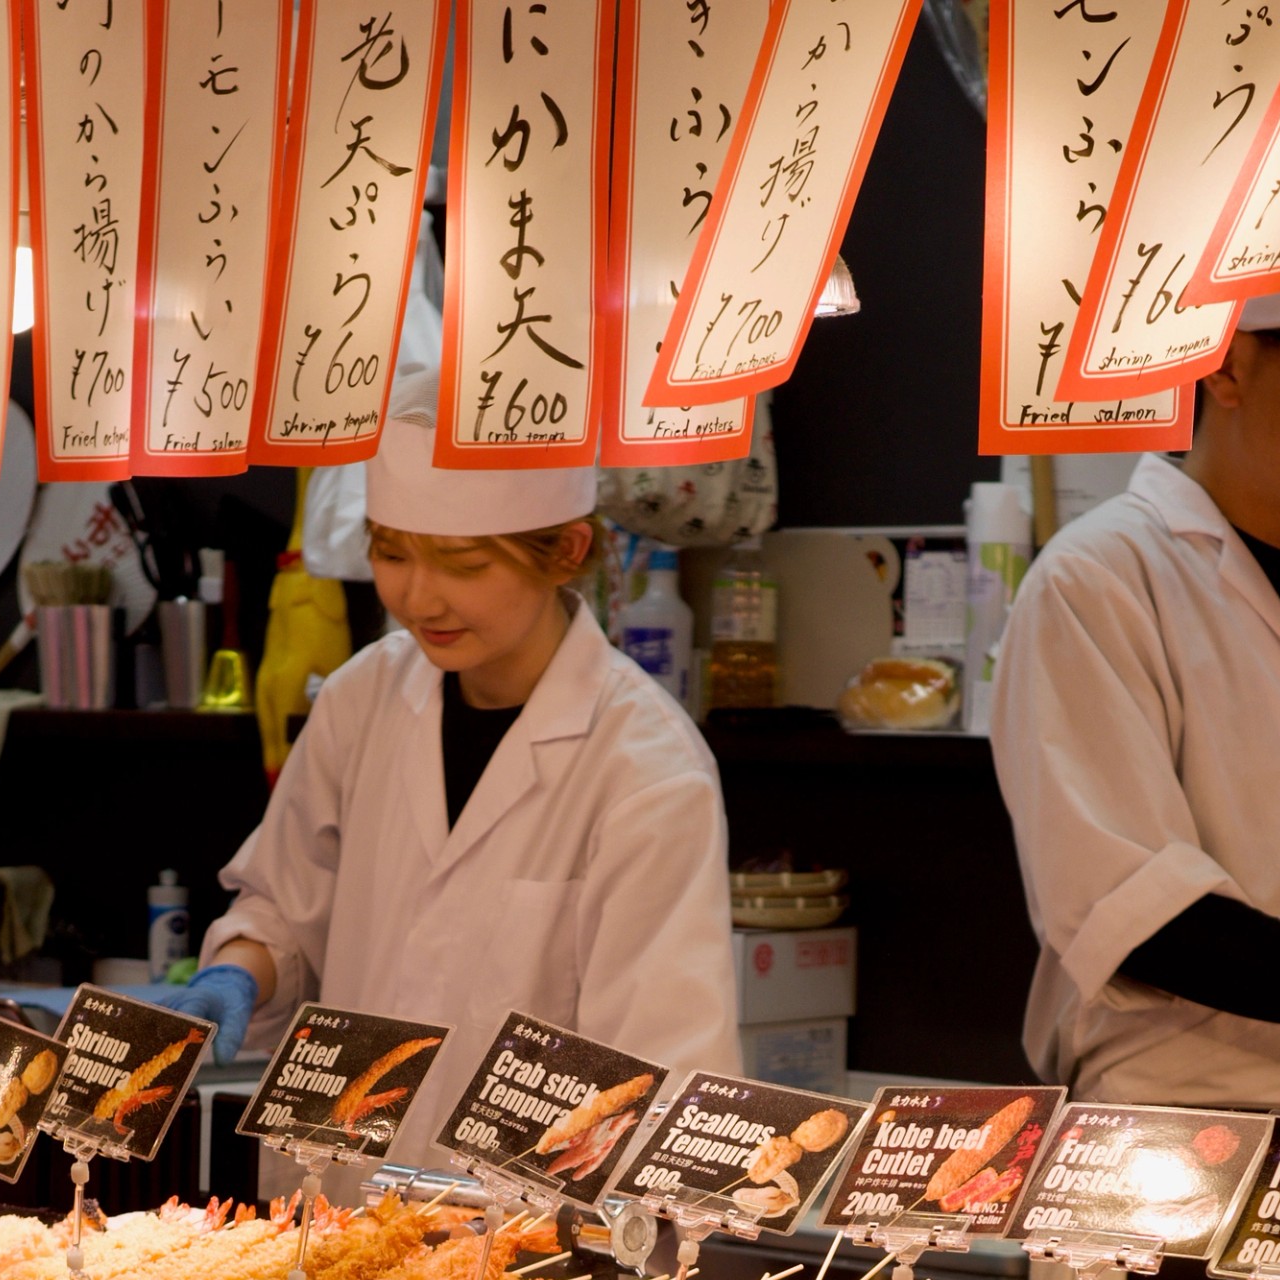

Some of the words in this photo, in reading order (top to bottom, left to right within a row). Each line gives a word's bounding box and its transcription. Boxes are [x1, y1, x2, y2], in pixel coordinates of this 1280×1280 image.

[320, 11, 413, 329] 老天ぷら
[479, 3, 585, 371] にかま天
[696, 291, 783, 364] ¥700
[70, 348, 124, 406] ¥700
[292, 323, 379, 401] ¥600
[689, 362, 724, 382] Fried
[734, 351, 778, 376] octopus
[1098, 347, 1153, 380] shrimp
[162, 347, 248, 427] ¥500
[473, 370, 568, 442] ¥600
[1019, 402, 1075, 426] Fried
[1092, 400, 1158, 424] salmon
[62, 421, 97, 450] Fried
[164, 431, 200, 453] Fried
[281, 411, 337, 448] shrimp
[488, 423, 518, 444] crab
[653, 420, 690, 439] Fried
[696, 419, 734, 445] oysters
[67, 1022, 131, 1064] Shrimp
[288, 1038, 343, 1068] Fried
[63, 1052, 132, 1091] empura
[276, 1063, 348, 1098] Shrimp
[492, 1049, 547, 1090] Crab
[542, 1072, 600, 1111] stick
[256, 1102, 297, 1128] 700円
[478, 1073, 571, 1129] Tempura
[454, 1116, 501, 1151] 600円
[675, 1104, 776, 1146] Scallops
[872, 1121, 934, 1149] Kobe
[933, 1123, 993, 1150] beef
[659, 1127, 762, 1170] Tempura
[861, 1148, 936, 1177] Cutlet
[1055, 1137, 1124, 1167] Fried
[633, 1164, 685, 1193] 800円
[840, 1190, 905, 1217] 2000円
[976, 1214, 1003, 1225] Seller
[1022, 1205, 1080, 1231] 600円
